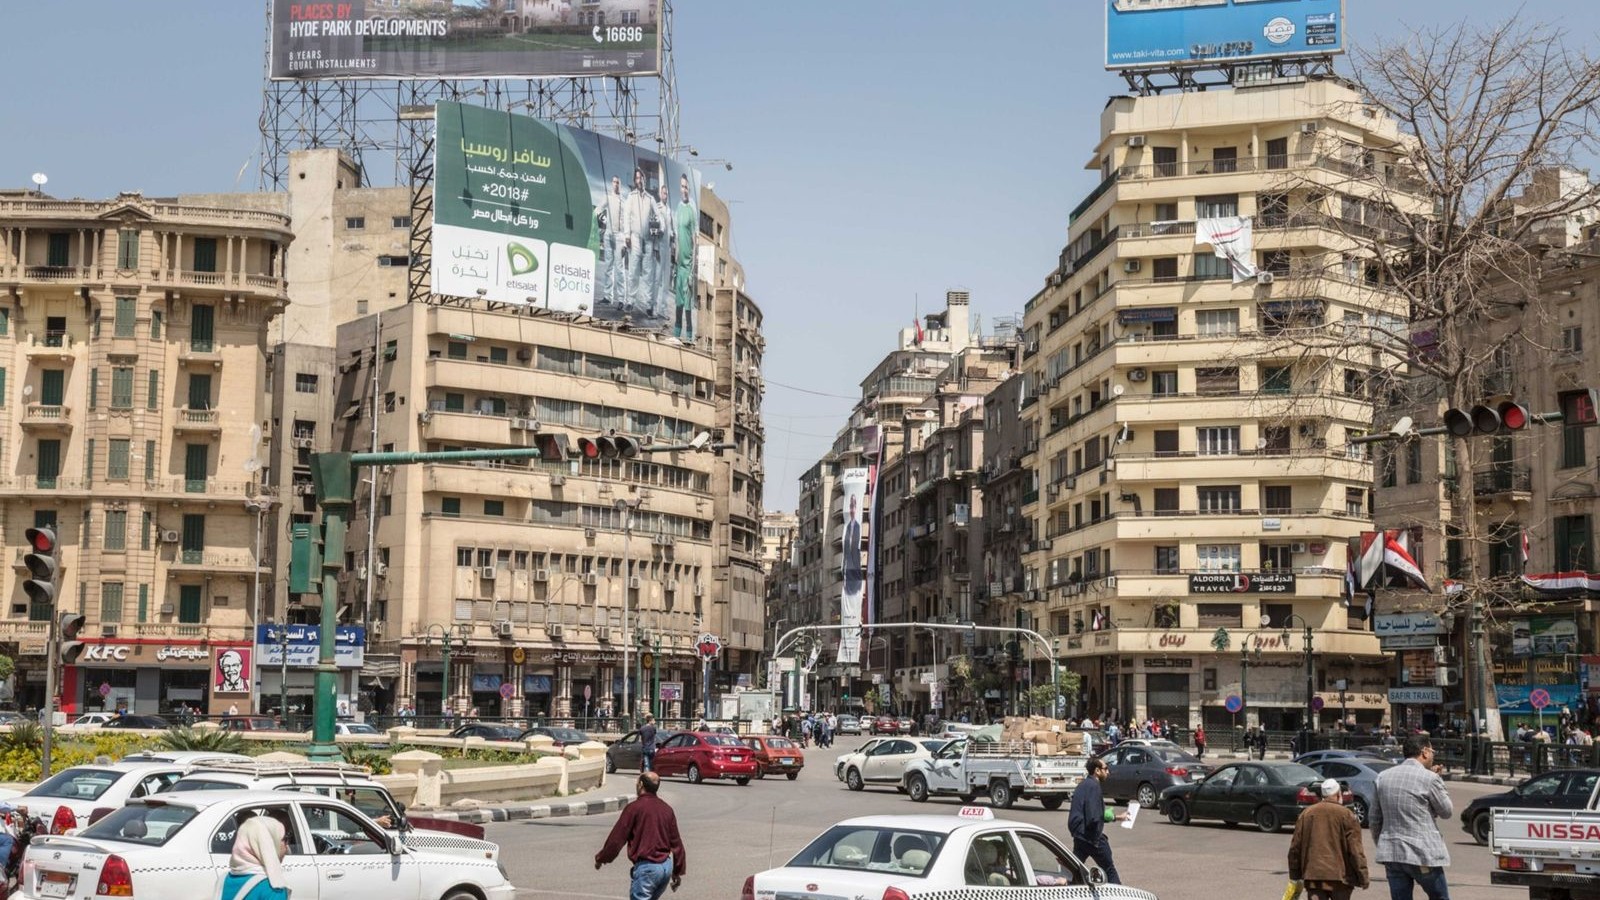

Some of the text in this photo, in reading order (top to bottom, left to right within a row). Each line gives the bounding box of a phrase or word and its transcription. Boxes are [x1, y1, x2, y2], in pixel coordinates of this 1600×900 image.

[290, 3, 352, 20] PLACES BY
[290, 20, 447, 37] HYDE PARK DEVELOPMENTS
[606, 26, 643, 42] 16696
[289, 50, 322, 60] 8 YEARS
[1112, 48, 1184, 60] www.taki-vita.com
[289, 59, 376, 71] EQUAL INSTALLMENTS
[461, 137, 551, 167] سافر روسيا
[472, 208, 490, 219] مصر
[513, 214, 528, 226] كل
[554, 264, 591, 279] etisalat
[506, 280, 538, 292] etisalat
[553, 276, 590, 293] sports
[1376, 616, 1437, 632] سفير للسياحة
[1159, 633, 1186, 647] لبنان
[84, 645, 128, 660] KFC
[1390, 691, 1411, 700] SAFIR
[1413, 691, 1440, 700] TRAVEL
[962, 808, 985, 816] TAXI
